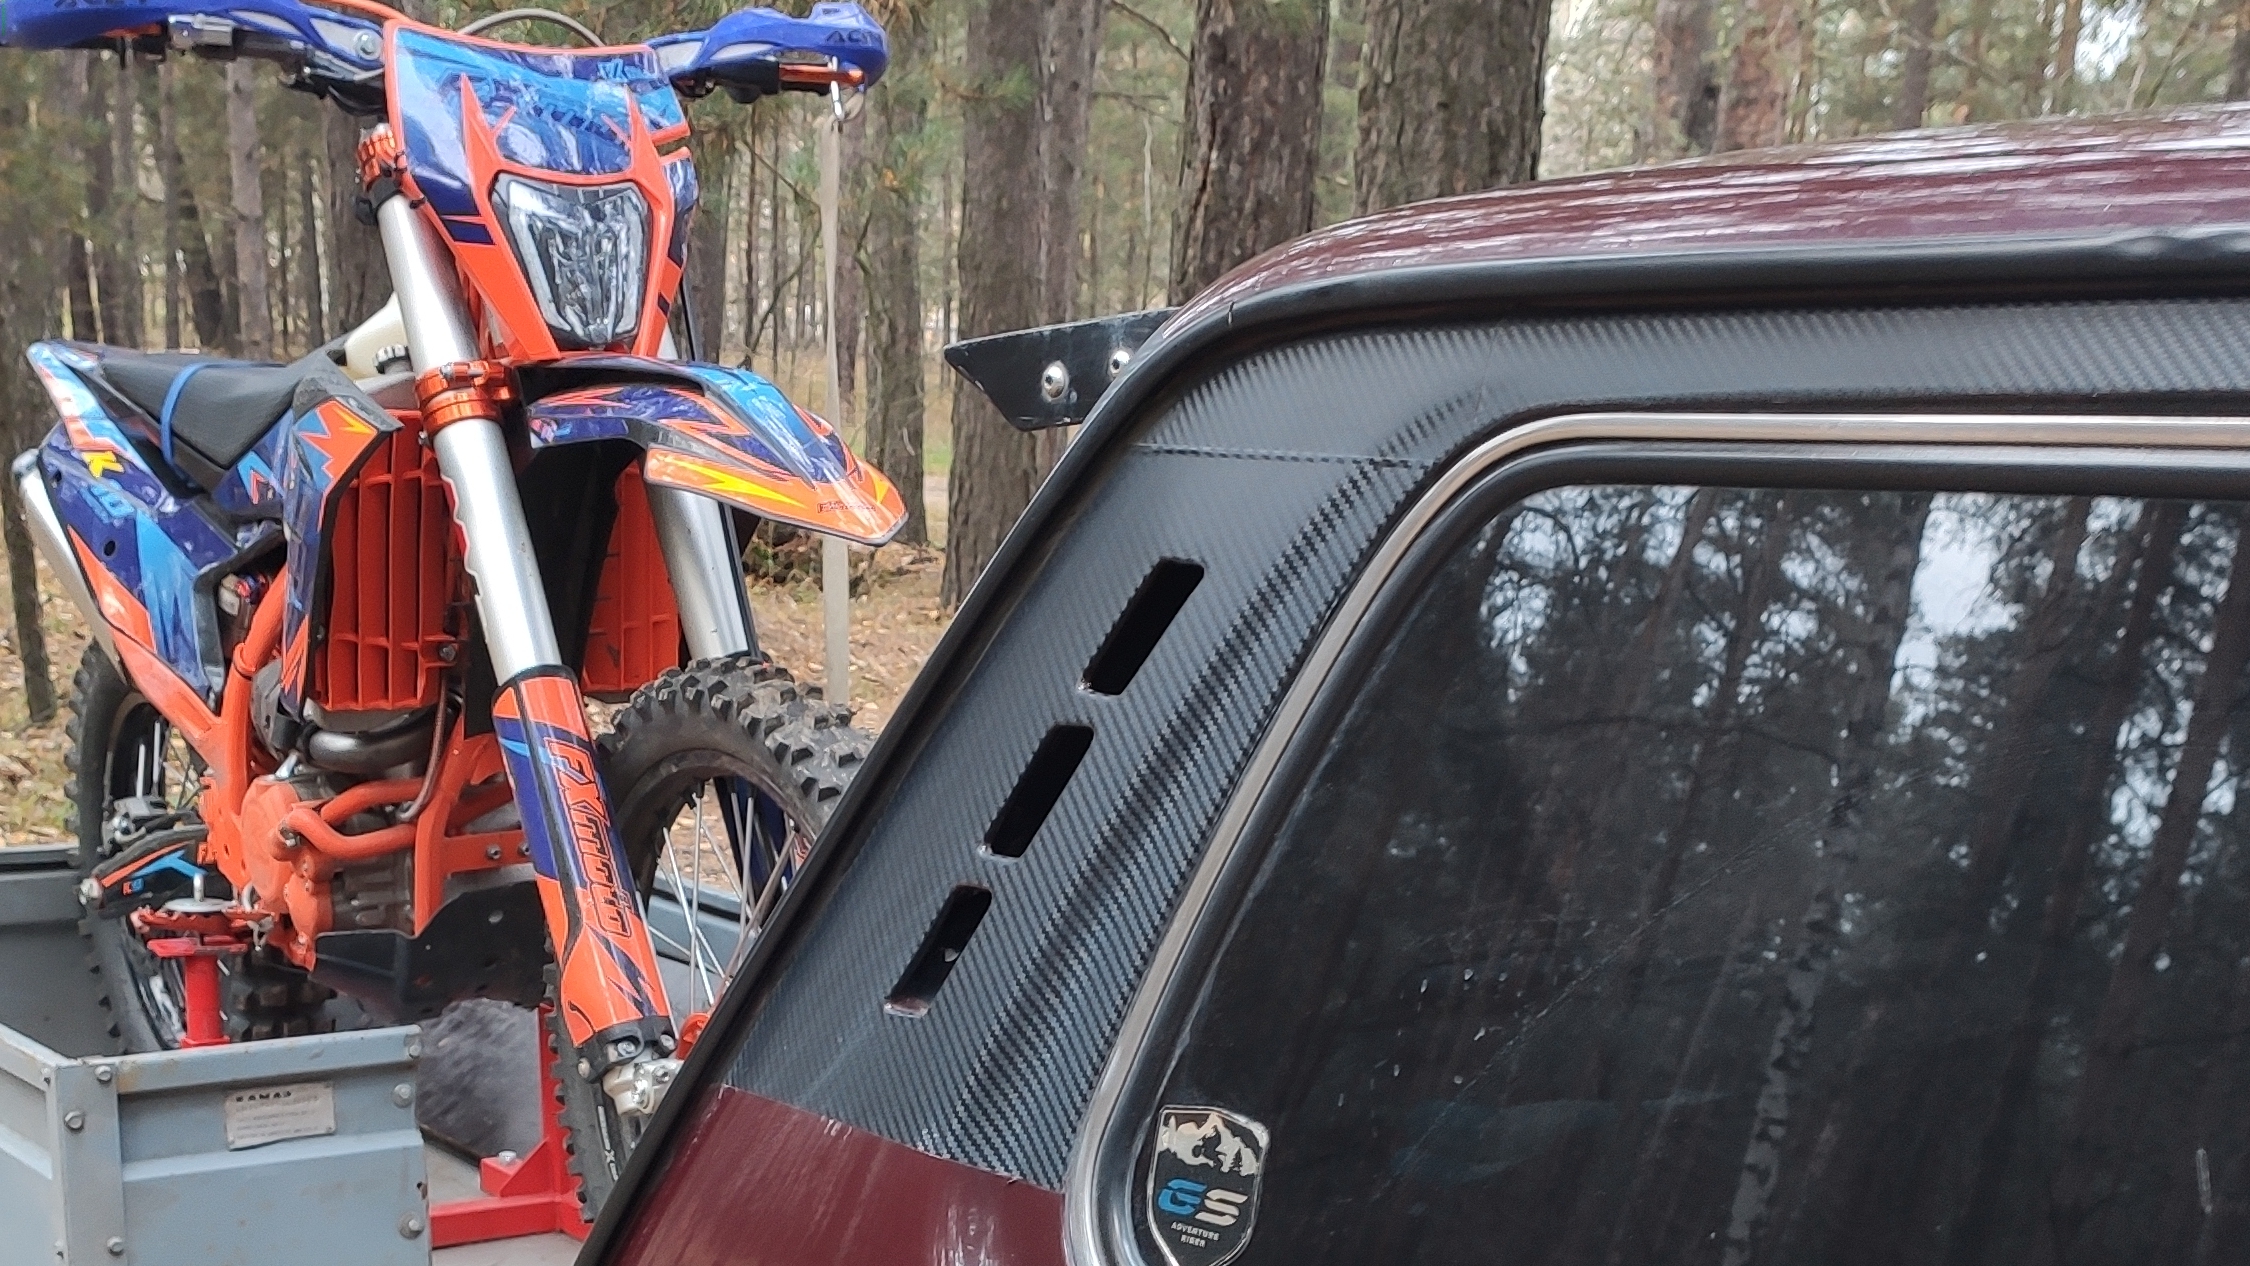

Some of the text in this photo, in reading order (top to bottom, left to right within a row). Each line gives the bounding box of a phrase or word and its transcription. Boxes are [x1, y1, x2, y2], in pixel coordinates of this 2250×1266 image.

[1158, 1178, 1249, 1227] GS
[1170, 1221, 1220, 1241] ADVENTURE
[1180, 1234, 1207, 1249] RIDER
